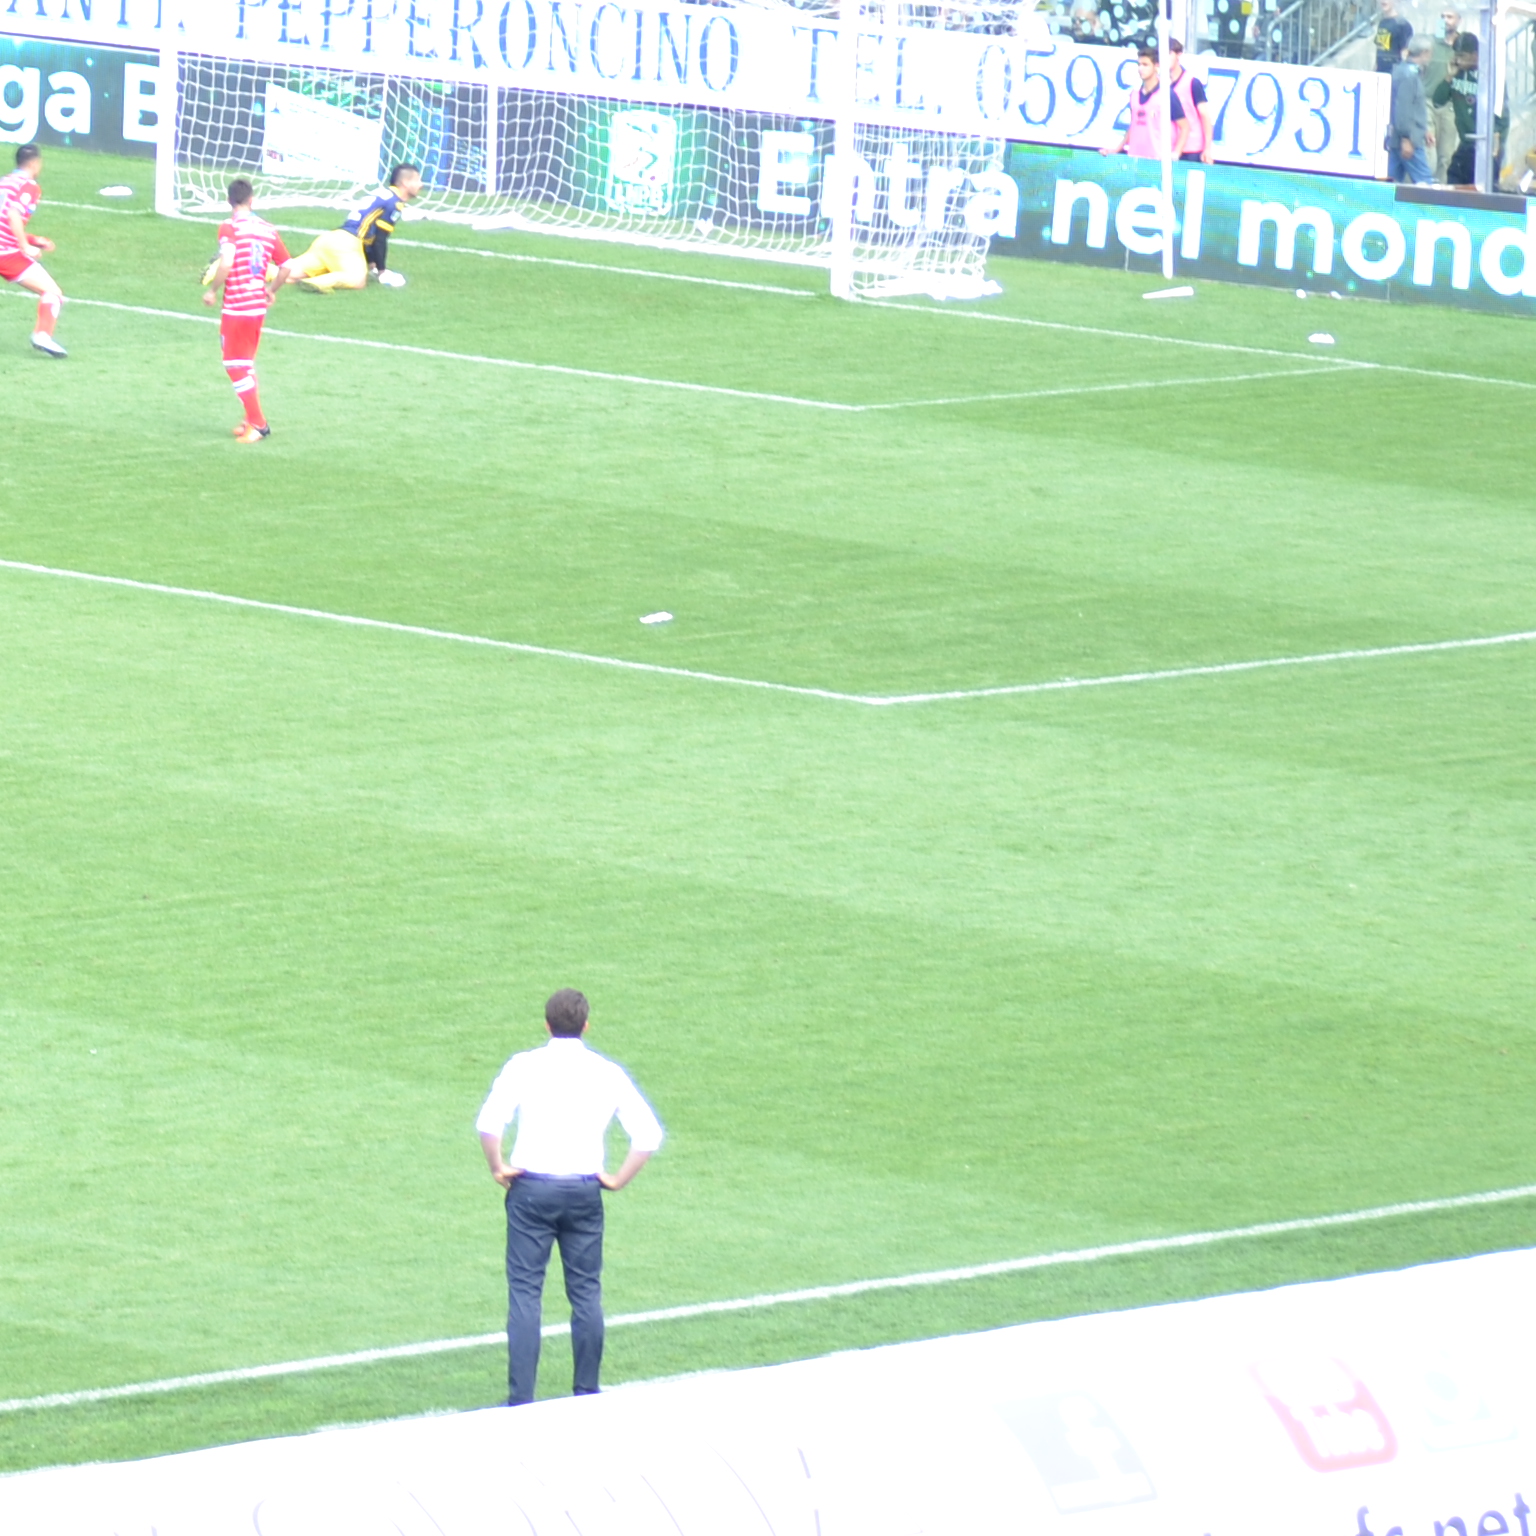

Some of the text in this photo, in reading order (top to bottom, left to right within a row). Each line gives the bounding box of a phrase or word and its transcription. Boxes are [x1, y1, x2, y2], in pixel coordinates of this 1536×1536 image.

[792, 24, 942, 114] TEL.
[975, 42, 1363, 158] 05927931
[757, 129, 1019, 239] Entra
[1051, 169, 1206, 260] nel
